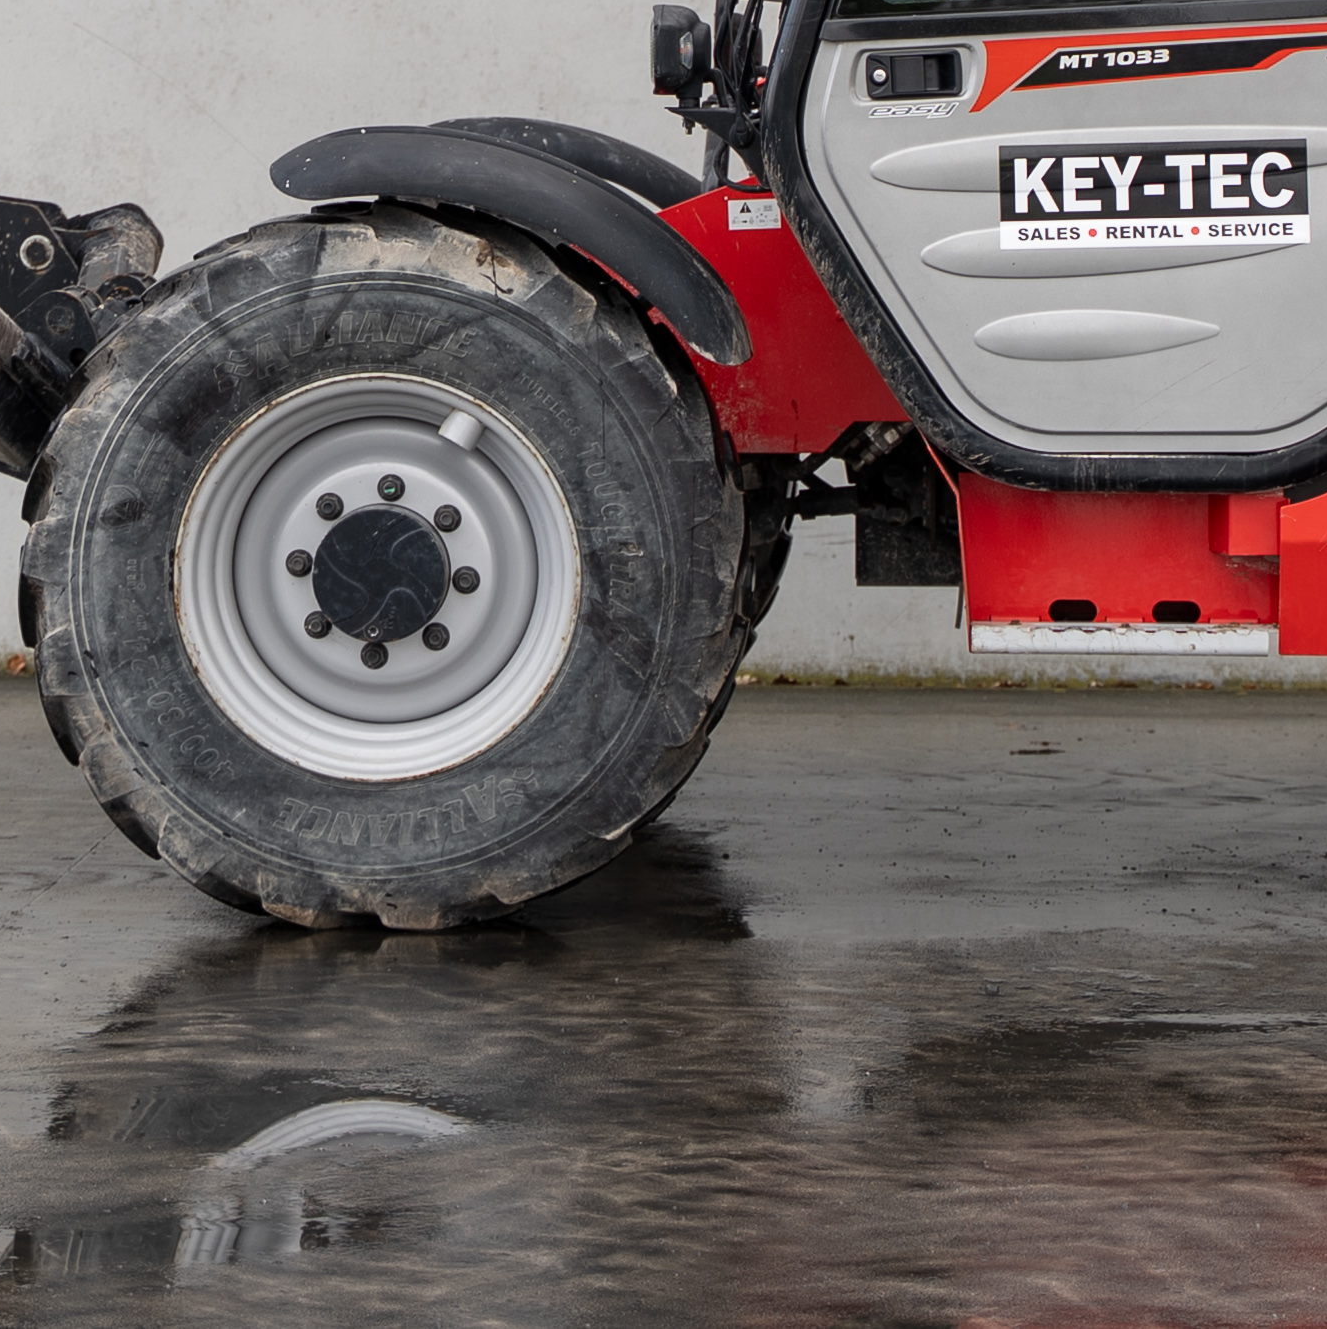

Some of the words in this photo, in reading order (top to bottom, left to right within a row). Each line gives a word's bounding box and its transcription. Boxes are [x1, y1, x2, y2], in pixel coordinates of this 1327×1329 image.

[1059, 53, 1098, 69] MT
[1103, 49, 1169, 66] 1033
[868, 102, 959, 119] easy
[1014, 152, 1295, 214] KEY-TEC
[1018, 227, 1081, 241] SALES
[1106, 225, 1184, 239] RENTAL
[1208, 222, 1294, 237] SERVICE
[237, 308, 480, 382] ALLIANCE
[516, 371, 582, 437] TUBELESS
[274, 772, 515, 847] ALLIANCE
